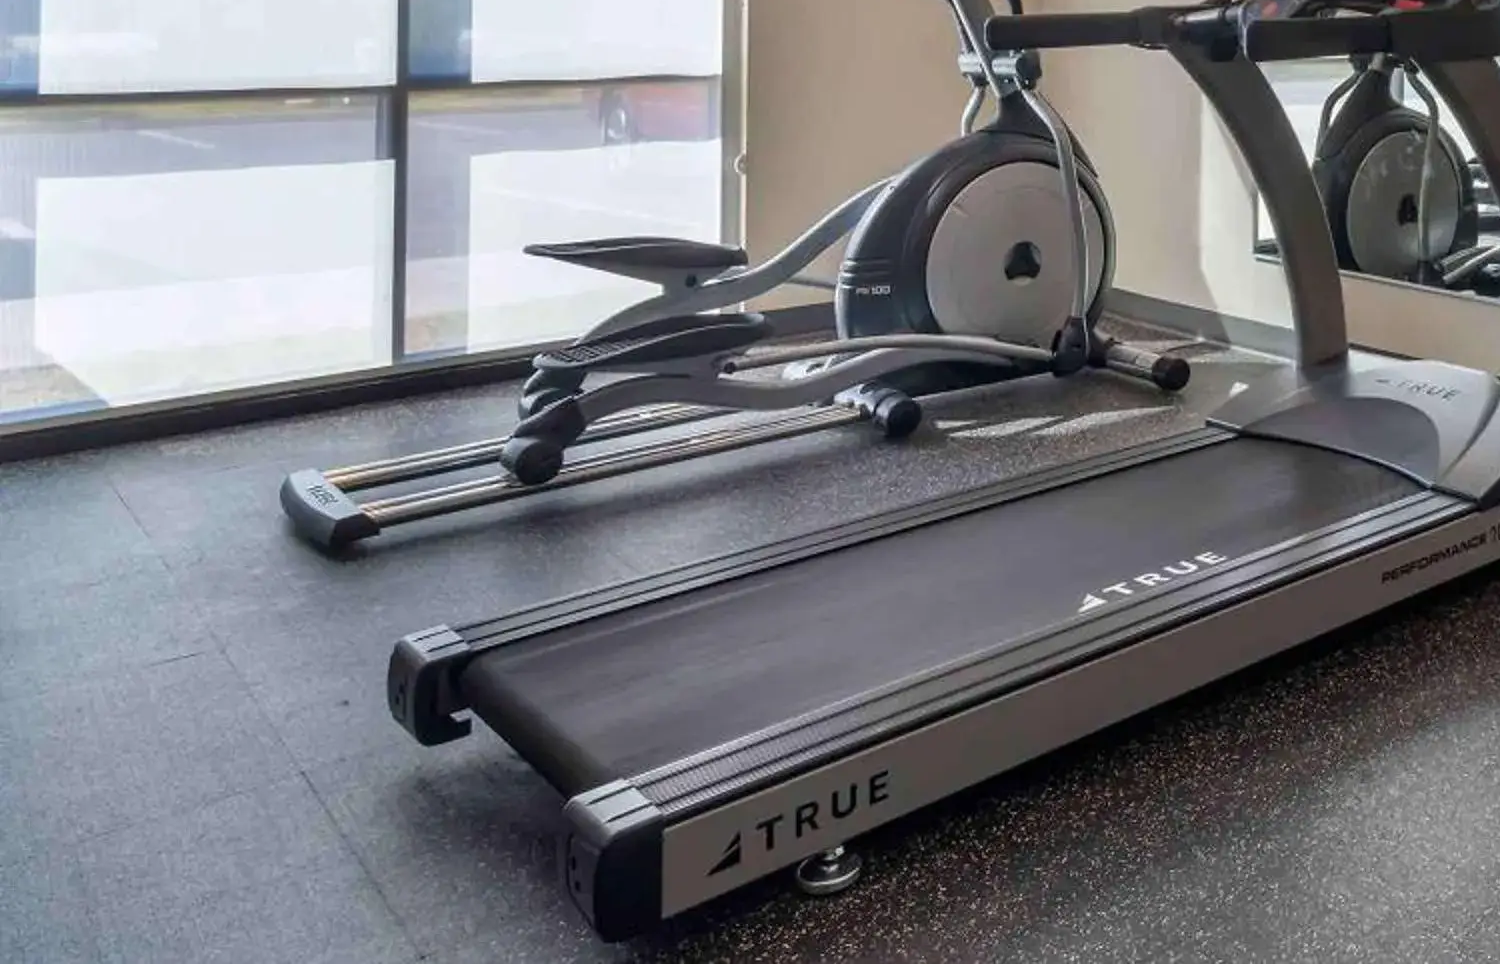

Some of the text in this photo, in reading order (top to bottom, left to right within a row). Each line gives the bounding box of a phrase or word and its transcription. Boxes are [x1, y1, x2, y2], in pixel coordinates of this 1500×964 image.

[1397, 379, 1461, 400] TRUE
[1101, 551, 1228, 595] TRUE
[1381, 533, 1488, 585] PERFORMANCE
[755, 769, 890, 851] TRUE
